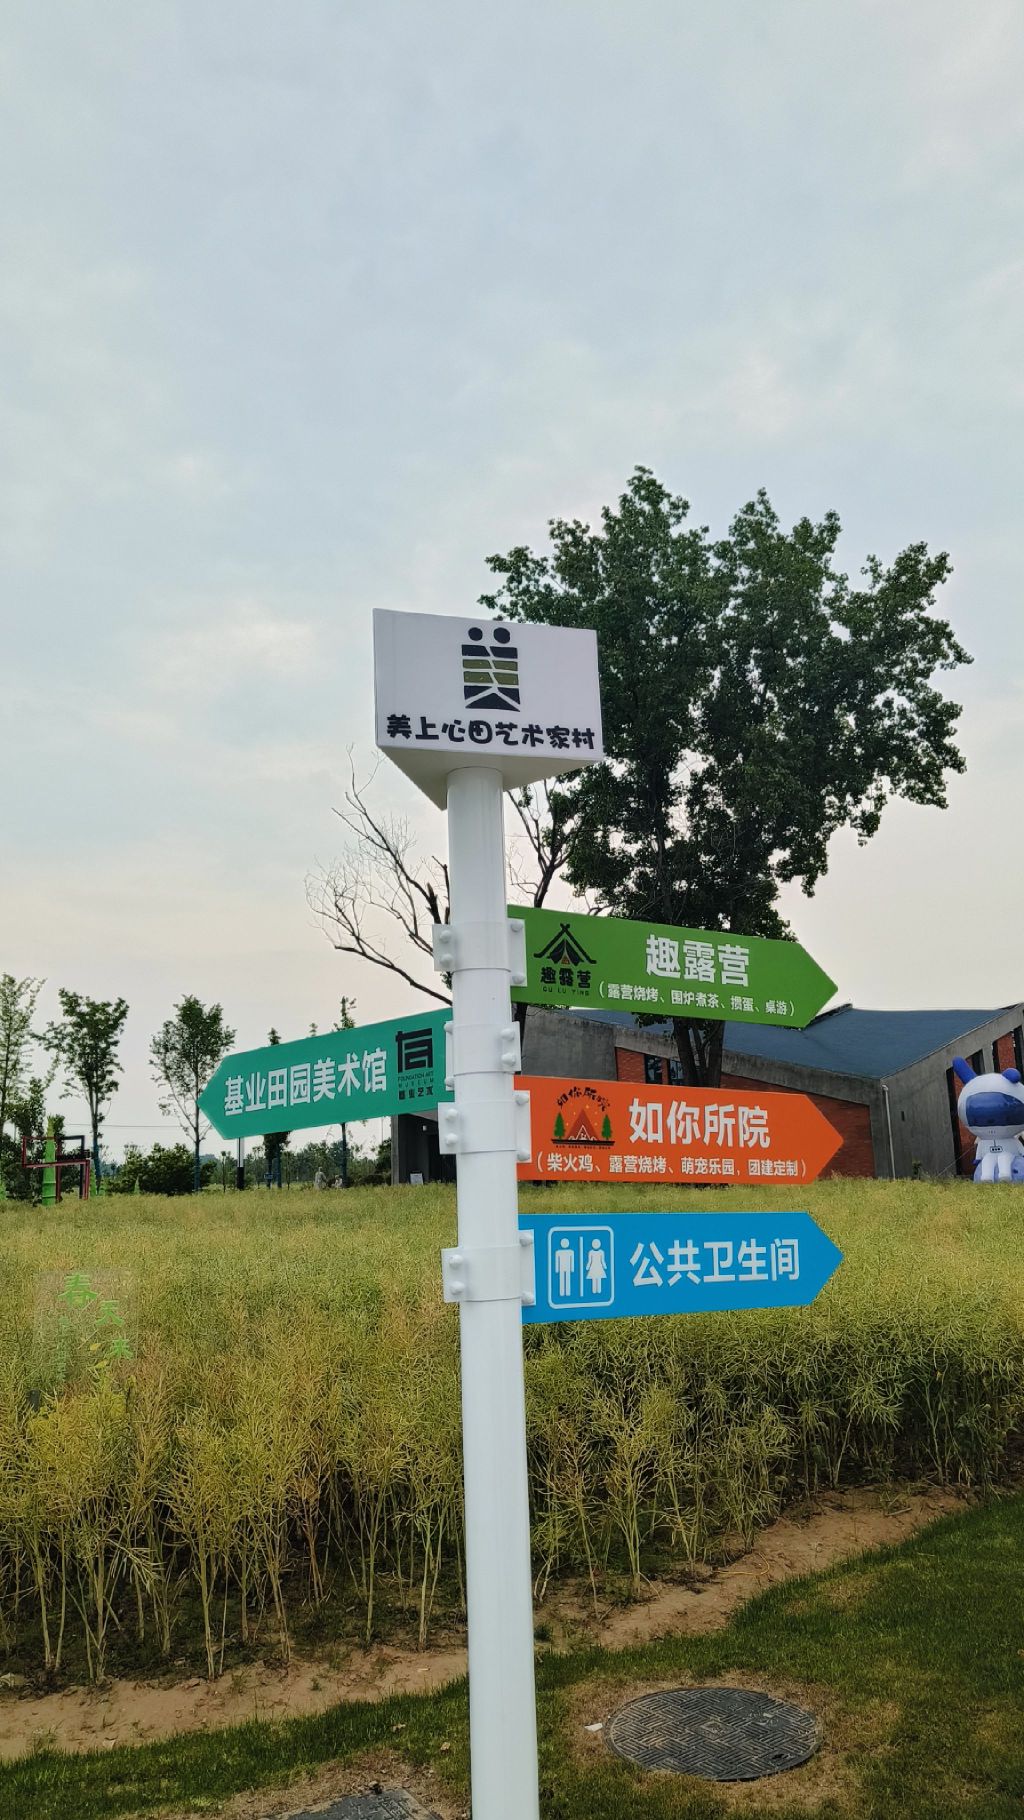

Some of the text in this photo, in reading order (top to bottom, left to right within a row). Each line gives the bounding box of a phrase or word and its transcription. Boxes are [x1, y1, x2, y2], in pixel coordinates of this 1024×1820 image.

[646, 934, 749, 987] 趣露营
[224, 1047, 387, 1116] 基业田园美术馆
[629, 1098, 770, 1149] 如你所院
[629, 1238, 800, 1287] 公共卫生间
